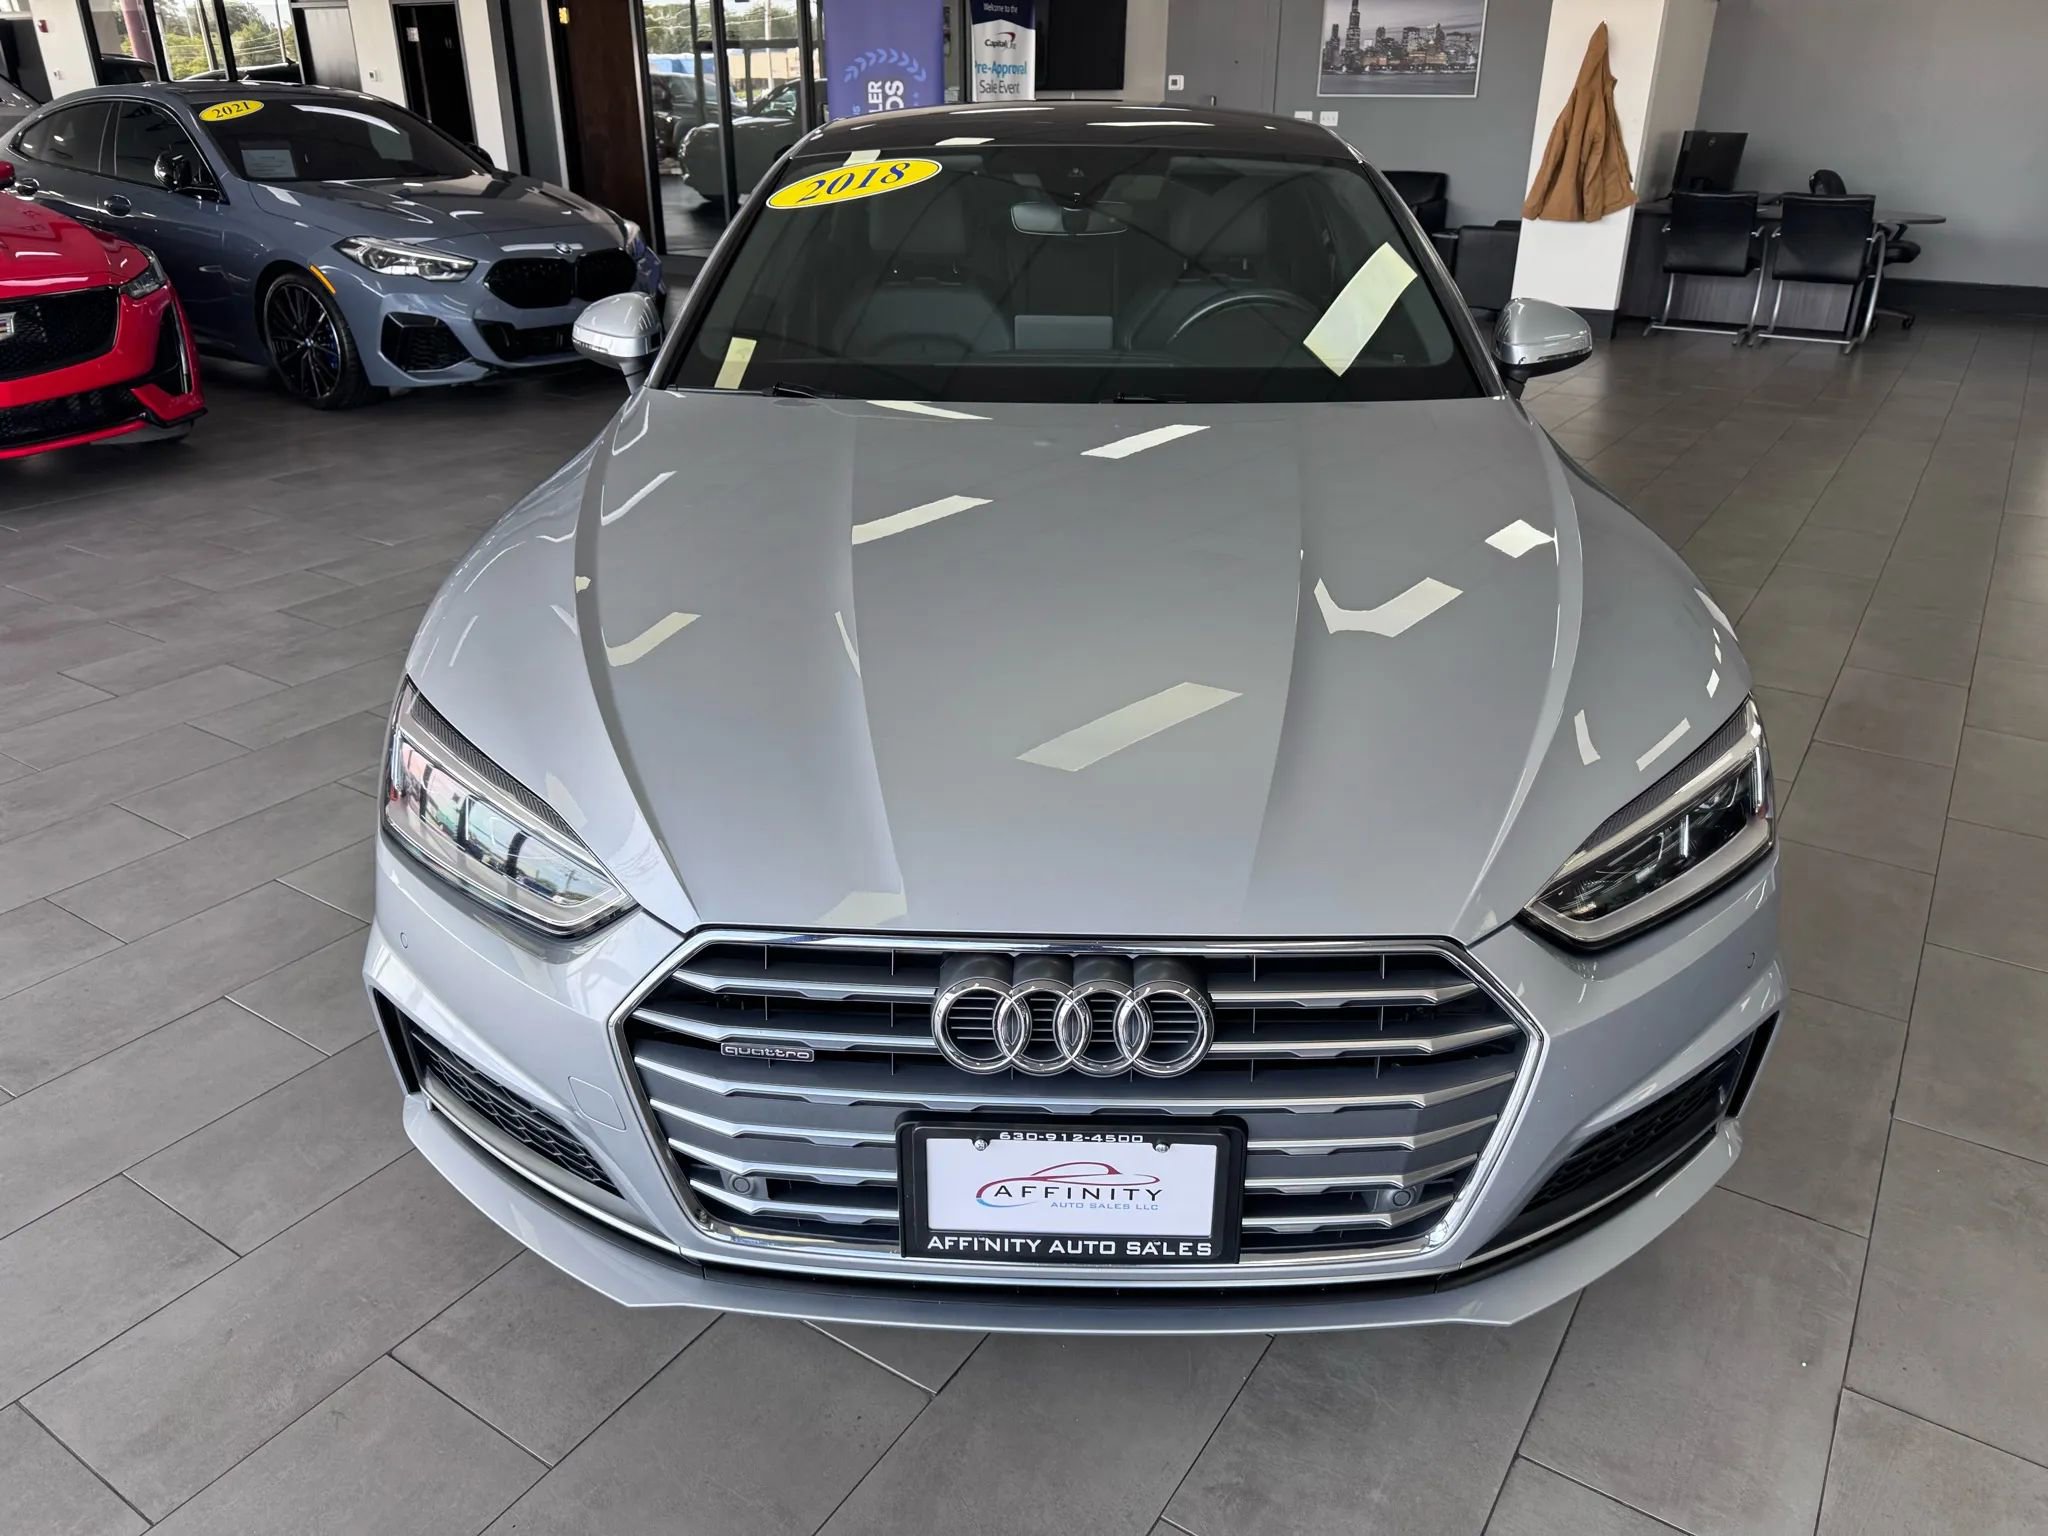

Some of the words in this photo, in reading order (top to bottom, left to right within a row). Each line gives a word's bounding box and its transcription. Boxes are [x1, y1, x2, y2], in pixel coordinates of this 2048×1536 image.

[983, 2, 1004, 13] Welcome
[1010, 5, 1018, 14] the
[979, 79, 997, 94] Sale
[999, 80, 1021, 94] Event
[211, 101, 250, 119] 2021
[796, 162, 911, 203] 2018
[724, 1046, 810, 1059] quattro
[999, 1131, 1144, 1143] 630-912-4500
[993, 1184, 1163, 1202] AFFINITY
[1050, 1201, 1084, 1209] AUTO
[1089, 1202, 1130, 1210] SALES
[1135, 1203, 1159, 1211] LLC
[927, 1236, 1042, 1253] AFFINITY
[1049, 1239, 1116, 1255] AUTO
[1126, 1241, 1212, 1256] SALES
